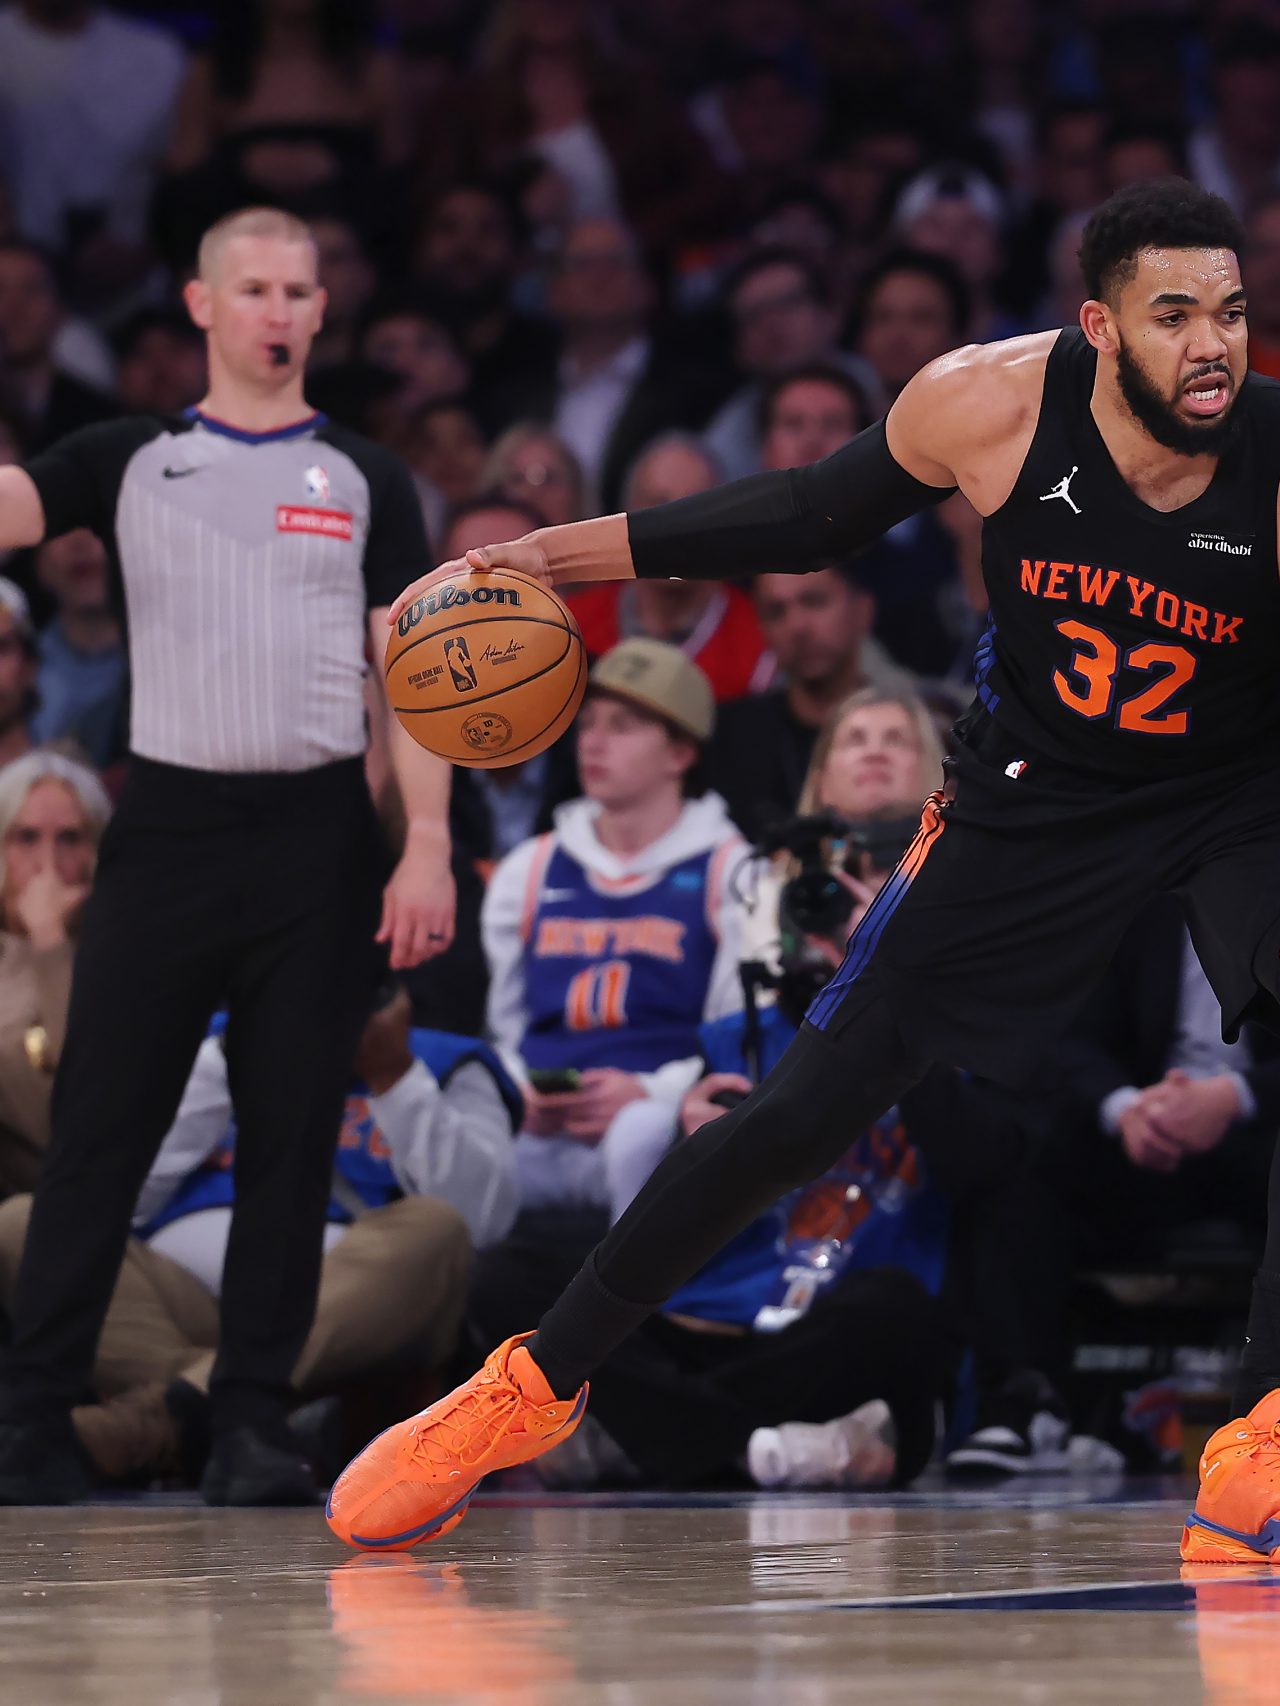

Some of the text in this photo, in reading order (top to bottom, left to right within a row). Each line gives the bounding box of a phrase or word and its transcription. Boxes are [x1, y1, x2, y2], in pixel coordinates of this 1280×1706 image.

[1188, 538, 1253, 556] abu dhabi
[1190, 532, 1225, 540] experience
[397, 584, 522, 637] Wilson
[1020, 558, 1245, 645] NEW YORK
[1051, 616, 1200, 736] 32
